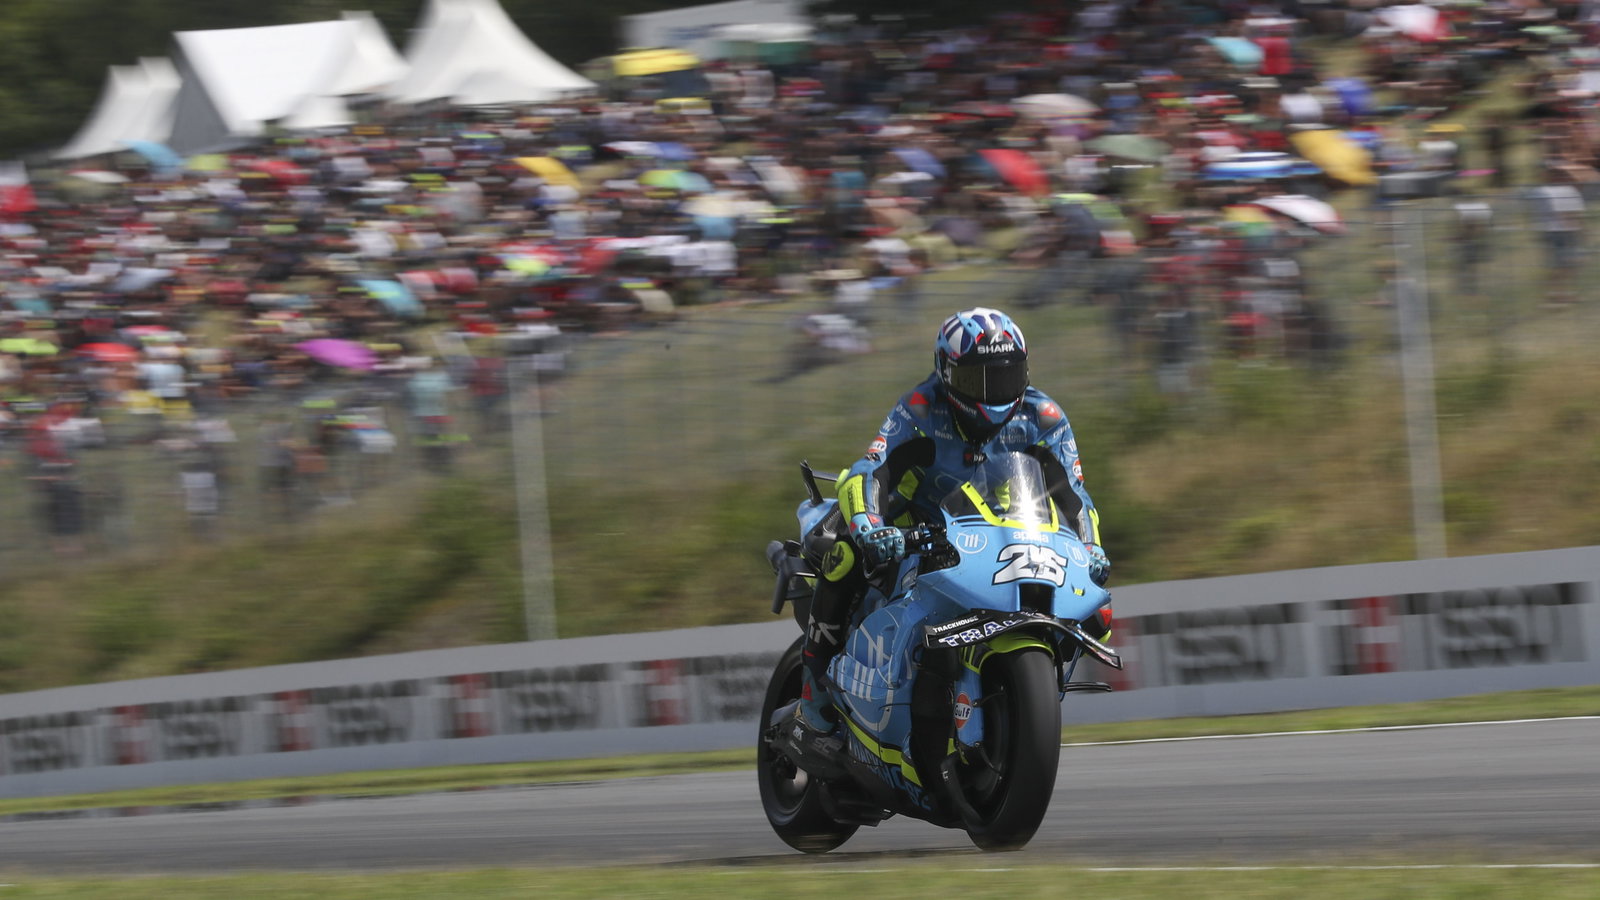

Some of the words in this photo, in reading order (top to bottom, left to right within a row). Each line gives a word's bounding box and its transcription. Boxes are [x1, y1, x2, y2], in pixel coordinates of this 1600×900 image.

[977, 343, 1014, 354] SHARK
[992, 543, 1068, 587] 25
[933, 615, 979, 633] TRACKHOUSE
[954, 704, 971, 718] Gulf
